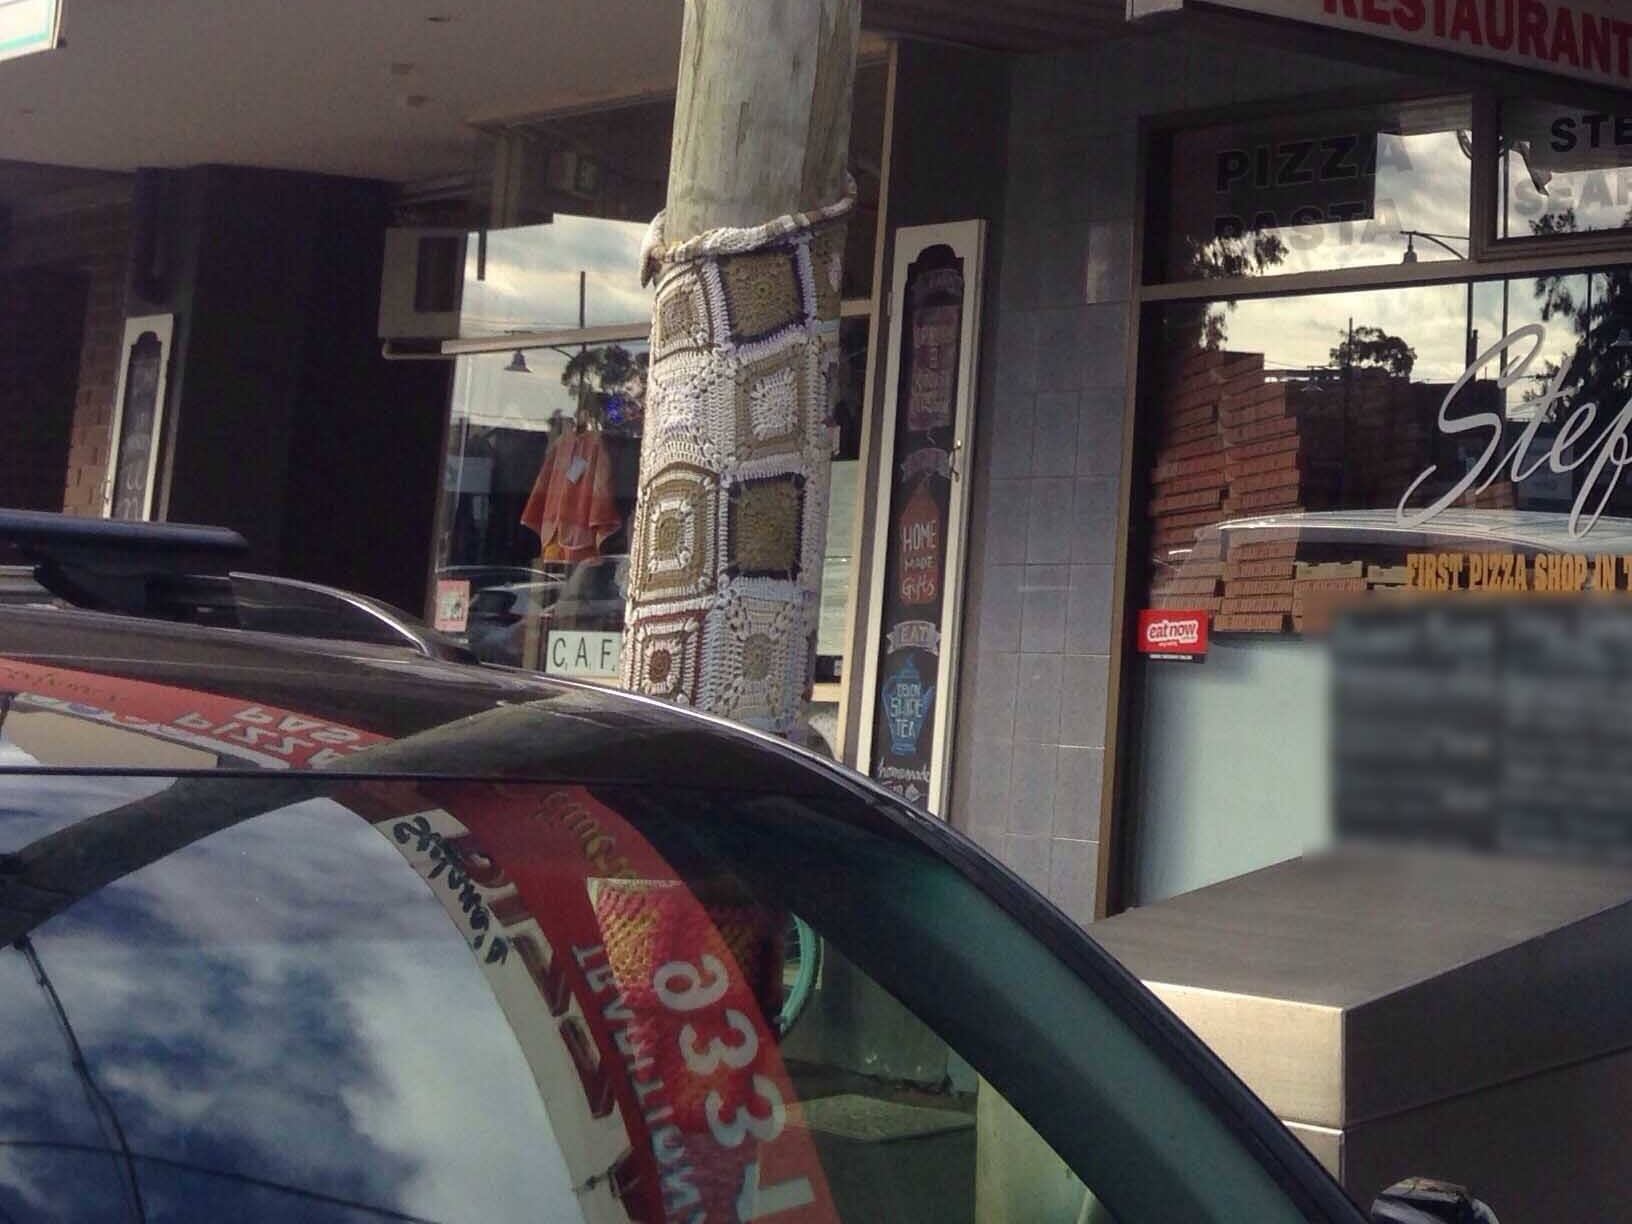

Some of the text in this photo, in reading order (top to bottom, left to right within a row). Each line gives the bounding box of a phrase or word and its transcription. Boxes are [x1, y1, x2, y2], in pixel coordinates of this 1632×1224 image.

[903, 519, 936, 554] HOME
[1407, 553, 1462, 592] FIRST
[1469, 553, 1527, 592] PIZZA
[1534, 552, 1588, 592] SHOP
[1594, 553, 1616, 592] IN
